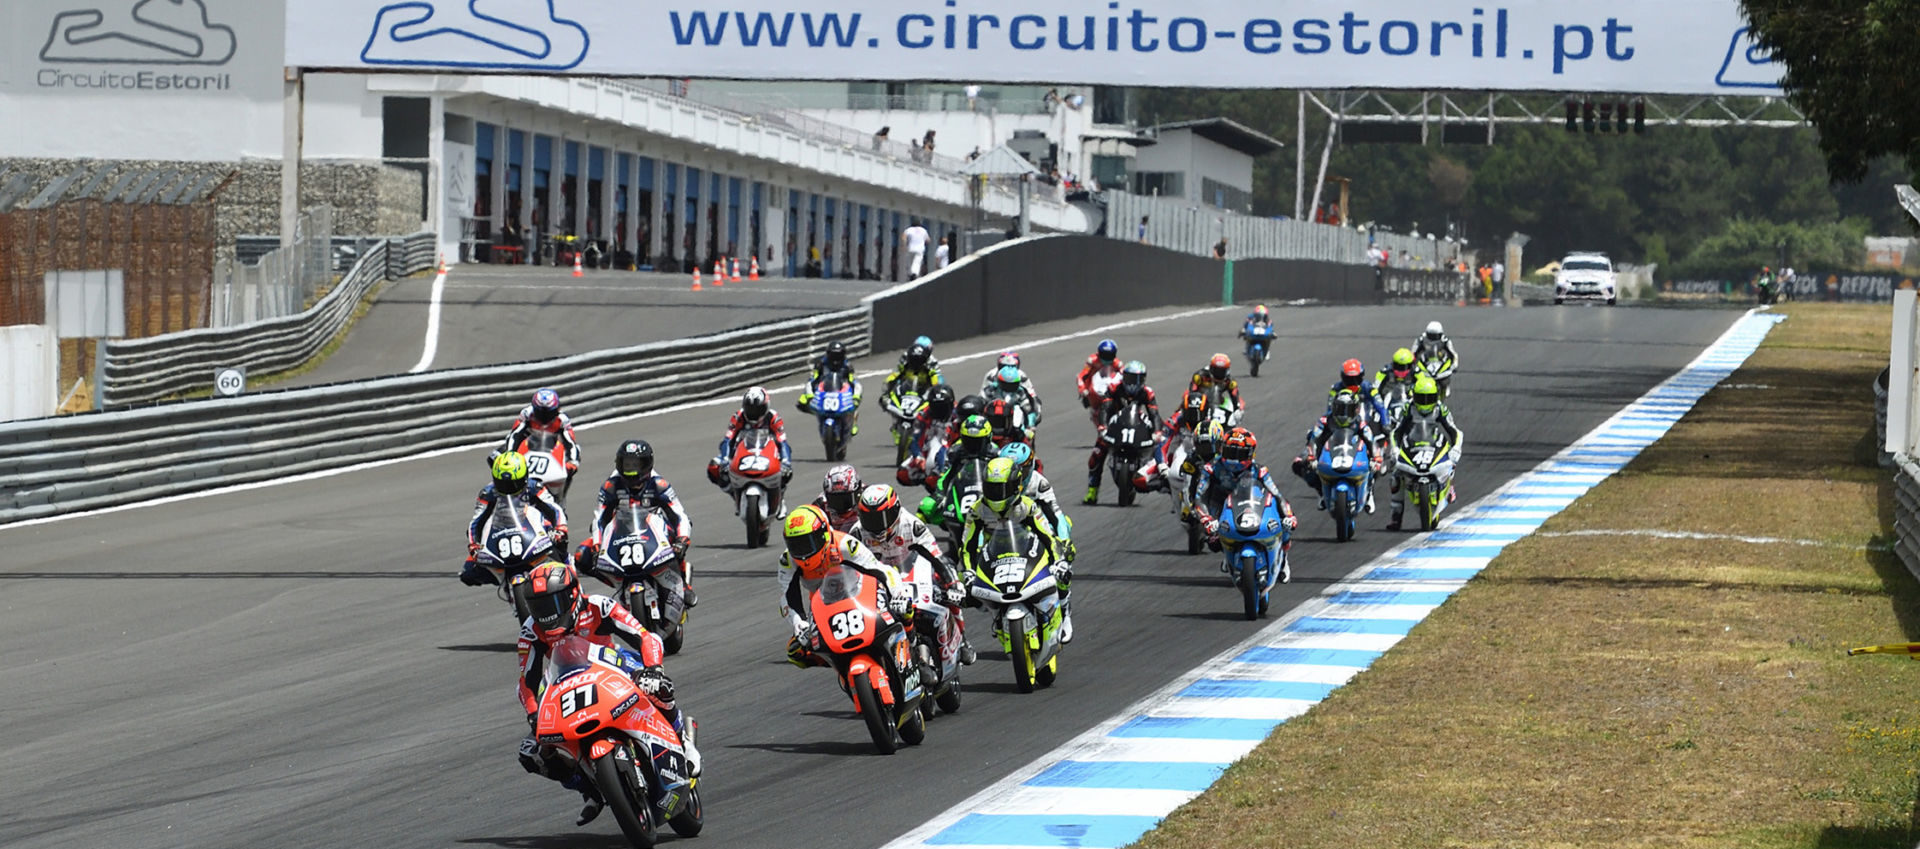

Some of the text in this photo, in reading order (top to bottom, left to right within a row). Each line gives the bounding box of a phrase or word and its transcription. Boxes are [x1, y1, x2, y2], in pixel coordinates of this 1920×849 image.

[669, 0, 1635, 74] www.circuito-estoril.pt
[37, 68, 230, 90] CircuitoEstoril
[1840, 275, 1892, 297] REPSOL
[221, 376, 240, 388] 60
[1121, 428, 1136, 443] 11
[528, 456, 549, 475] 70
[498, 535, 523, 559] 96
[619, 543, 645, 567] 28
[993, 563, 1027, 585] 25
[832, 608, 865, 640] 38
[562, 684, 594, 718] 37
